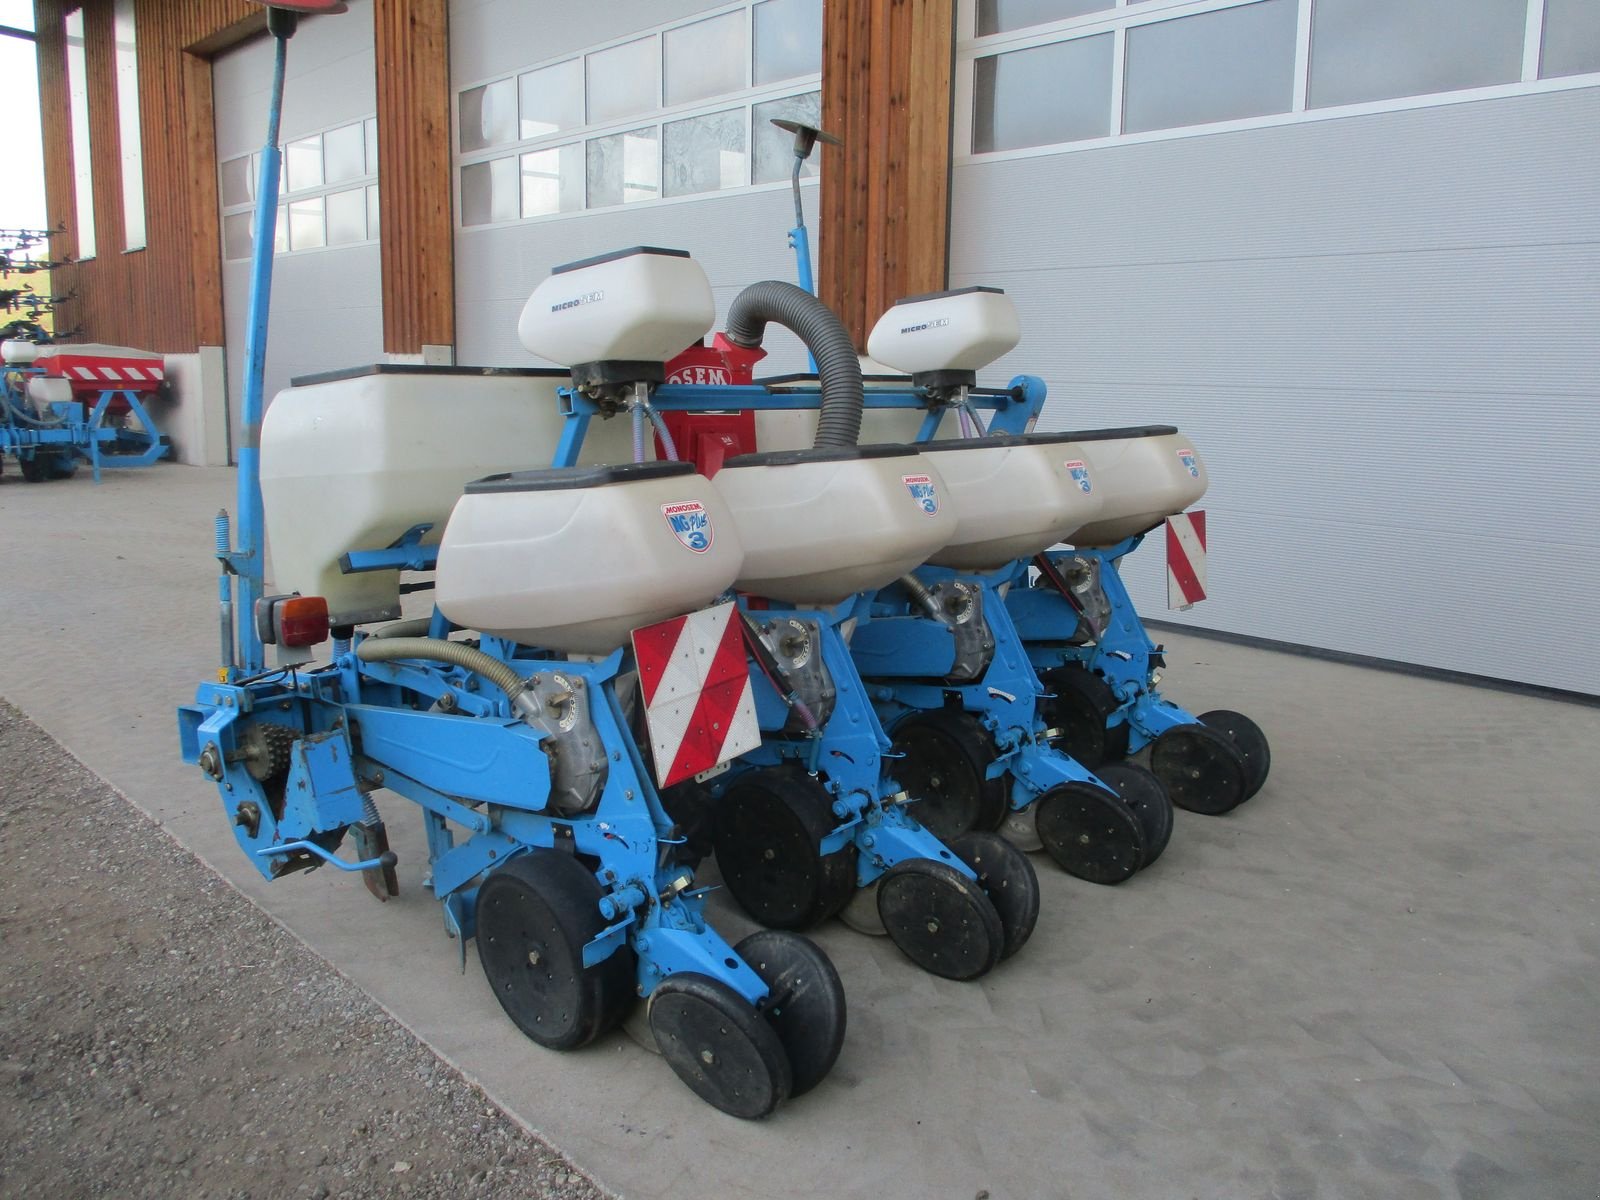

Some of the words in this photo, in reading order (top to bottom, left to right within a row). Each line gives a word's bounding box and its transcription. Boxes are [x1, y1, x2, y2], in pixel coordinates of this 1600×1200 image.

[665, 503, 702, 513] MONOSEM
[922, 498, 936, 513] 3
[670, 514, 690, 532] NG
[688, 531, 708, 549] 3
